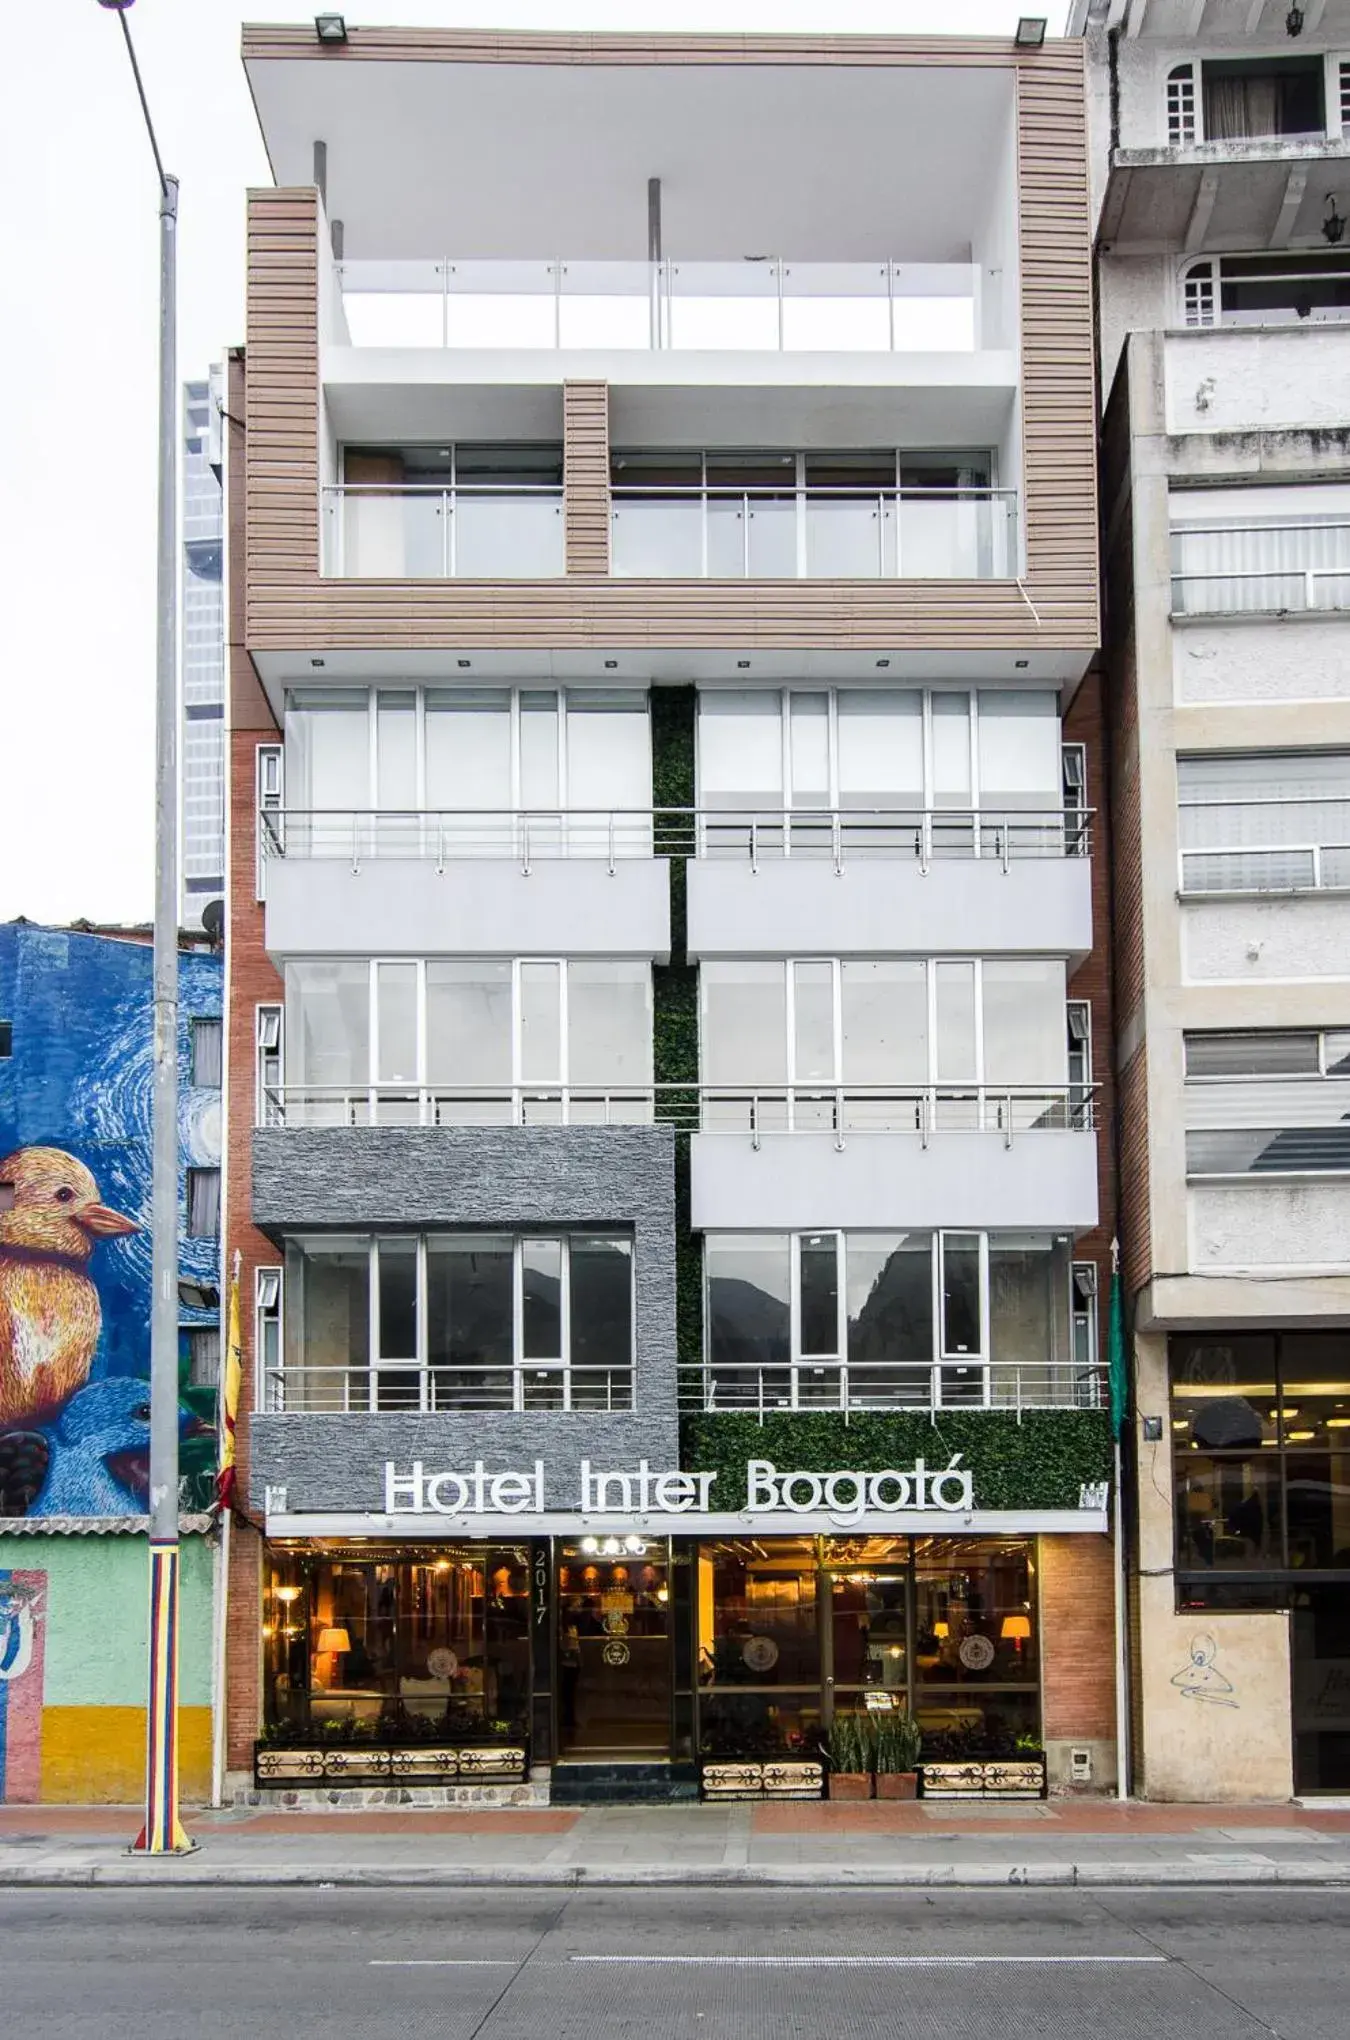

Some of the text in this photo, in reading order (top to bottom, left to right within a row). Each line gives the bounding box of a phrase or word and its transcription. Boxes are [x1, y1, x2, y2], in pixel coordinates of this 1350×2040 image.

[384, 1453, 973, 1527] Hotel Inter Bogotá
[535, 1550, 547, 1624] 2017
